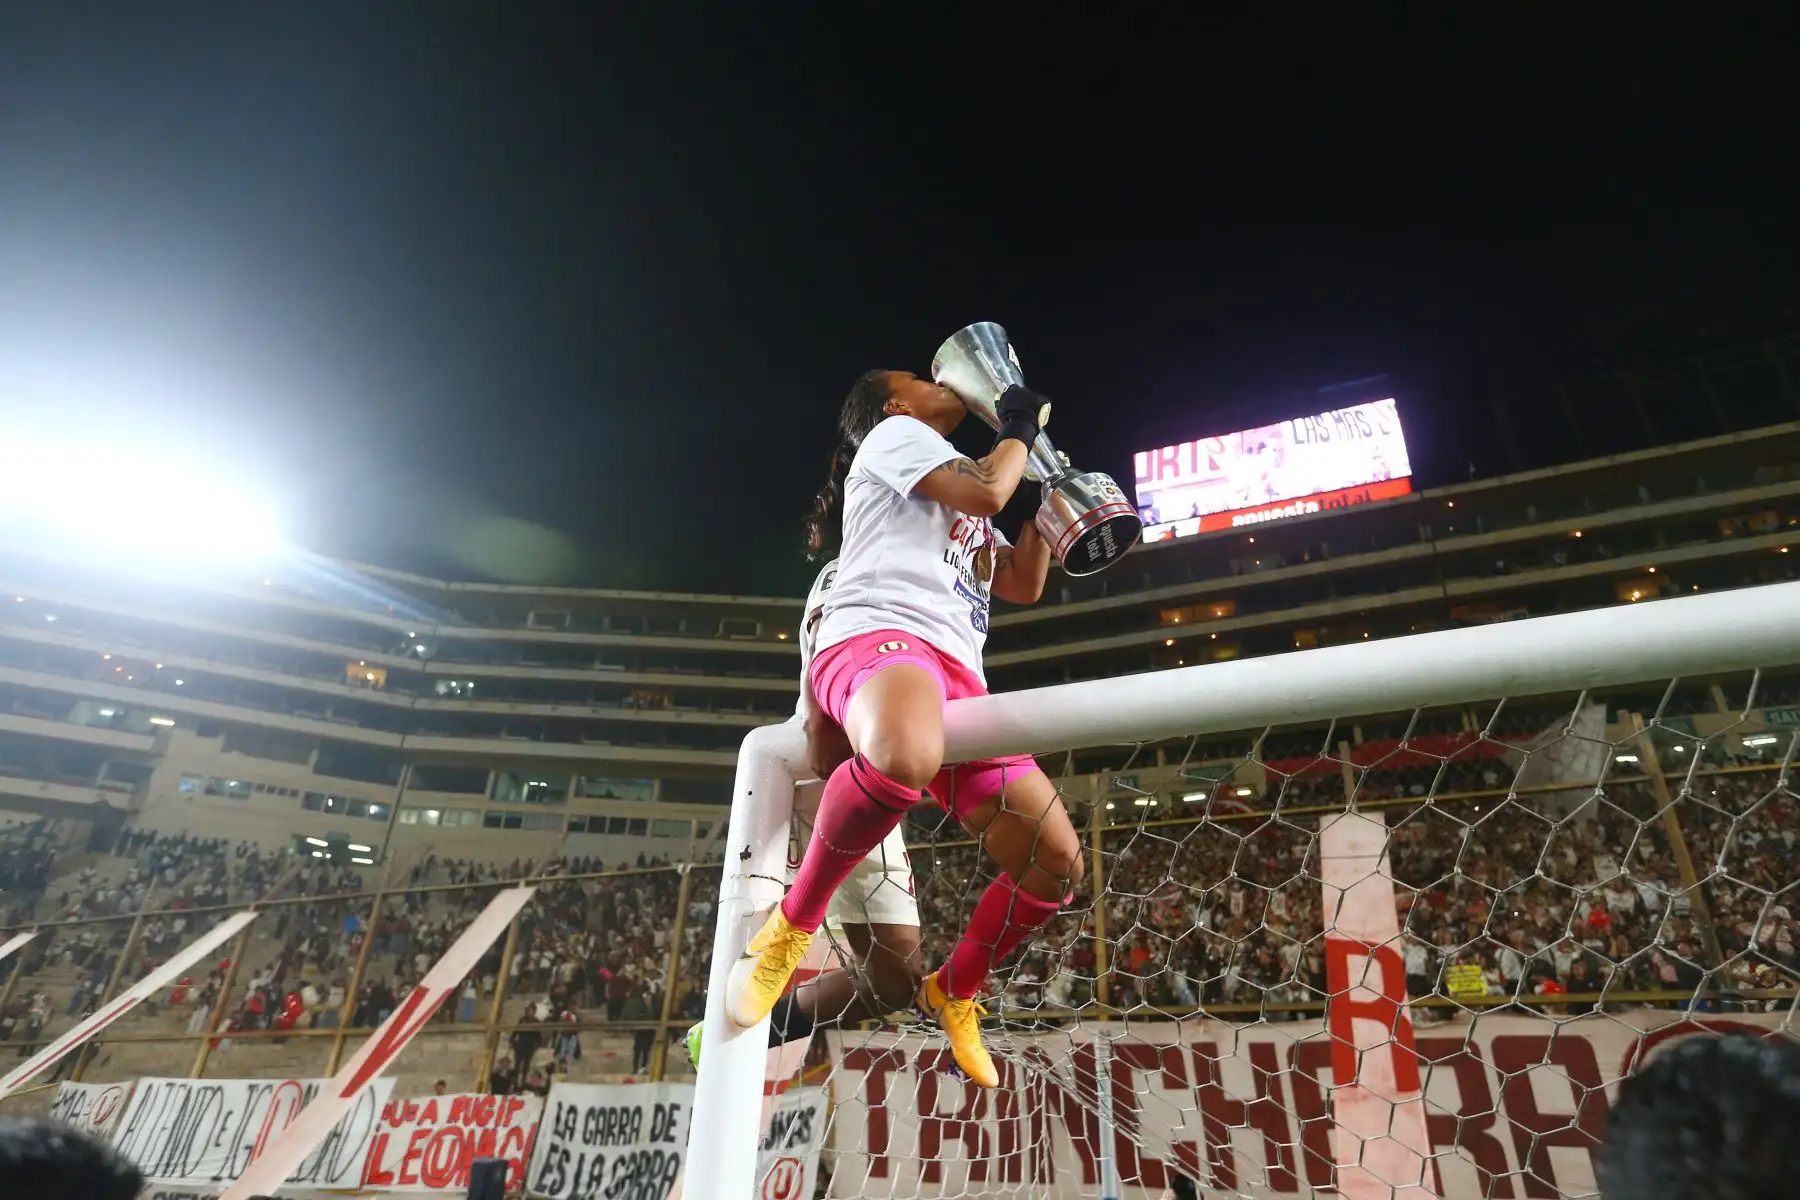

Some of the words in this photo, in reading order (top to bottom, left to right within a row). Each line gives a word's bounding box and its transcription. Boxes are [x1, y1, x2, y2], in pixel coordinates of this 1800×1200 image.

[943, 548, 961, 571] LIG
[1087, 537, 1102, 561] total
[1099, 524, 1118, 559] apuesta
[1325, 938, 1421, 1093] R
[553, 1102, 578, 1142] LA
[582, 1104, 642, 1146] GARRA
[650, 1102, 681, 1143] DE
[534, 1142, 571, 1196] ES
